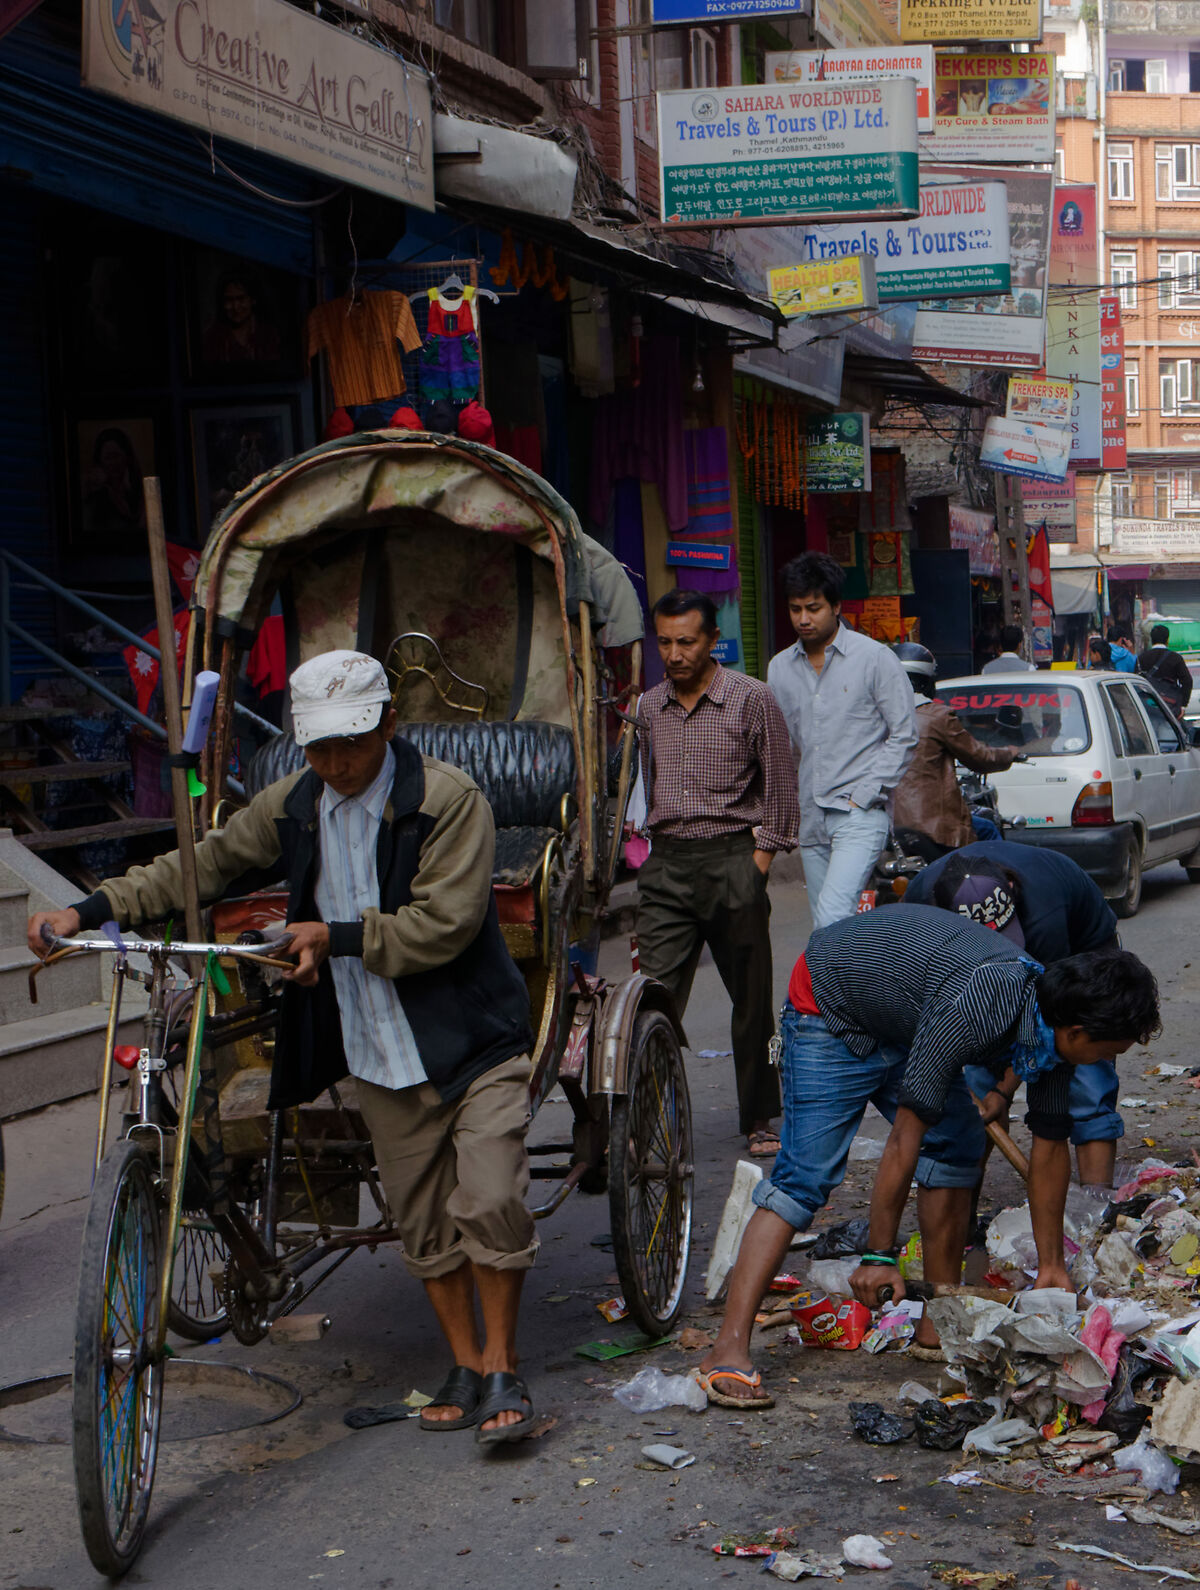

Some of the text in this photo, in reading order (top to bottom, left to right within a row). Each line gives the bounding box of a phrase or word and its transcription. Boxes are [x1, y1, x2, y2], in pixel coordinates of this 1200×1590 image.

[1007, 9, 1028, 17] Nepal
[866, 57, 923, 71] ENCHANTER
[935, 57, 1049, 76] REKKER'S SPA
[175, 0, 426, 172] Creative Art Gallery
[724, 88, 883, 113] SAHARA WORLDWIDE
[676, 107, 889, 141] Travels & Tours (P.) Ltd.
[956, 116, 1049, 126] Cure & Steam Bath
[749, 138, 778, 146] Thamel
[803, 230, 879, 260] Travels
[886, 228, 902, 257] &
[907, 226, 968, 256] Tours
[969, 239, 993, 250] Ltd.
[1052, 243, 1096, 254] AIROCHANA
[772, 269, 829, 289] HEALTH
[832, 264, 860, 280] SPA
[1013, 382, 1069, 399] TREKKER'S SPA
[1023, 489, 1070, 497] estaurant
[688, 550, 724, 561] PASHMINA
[949, 692, 1072, 711] SUZUKI
